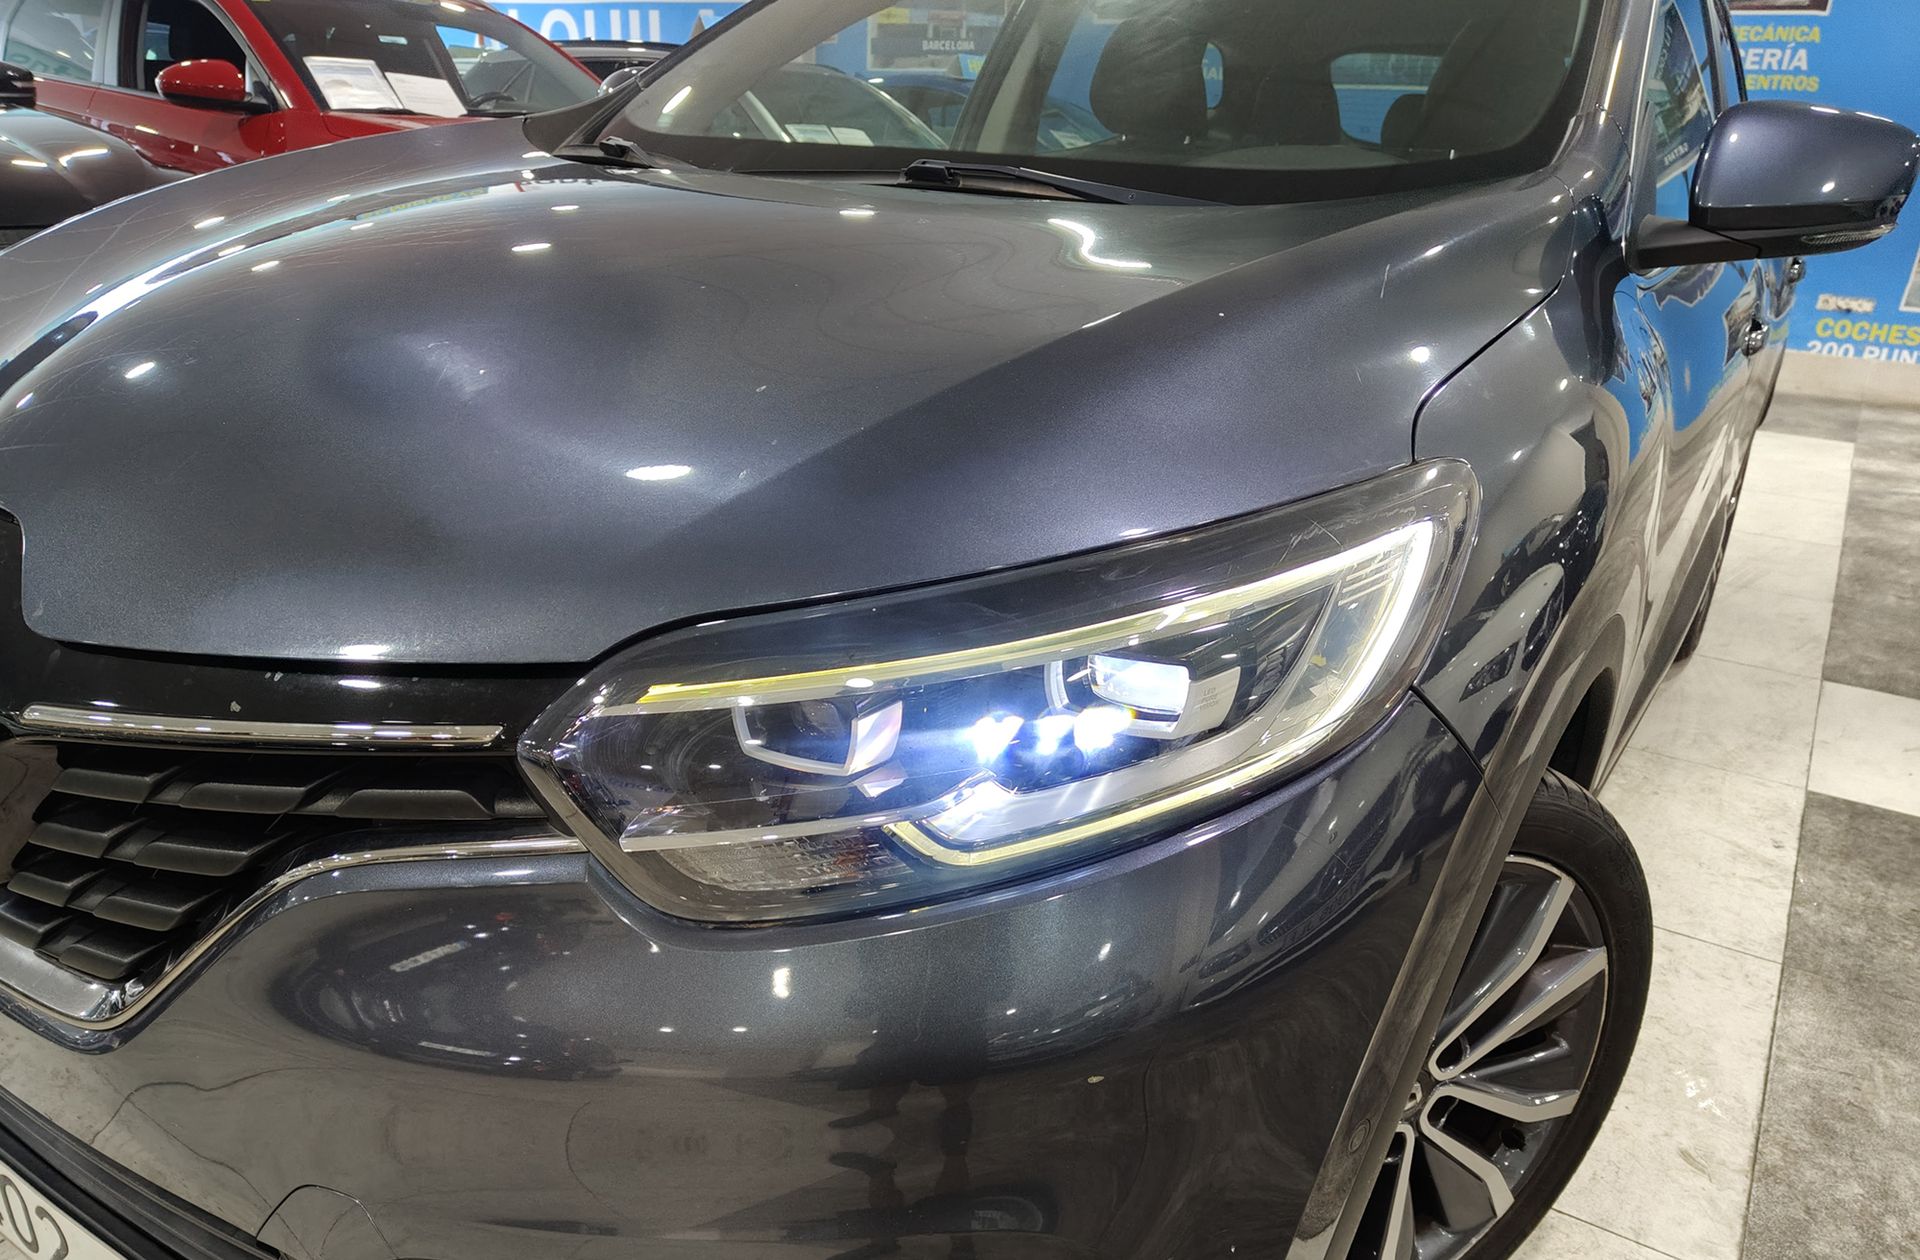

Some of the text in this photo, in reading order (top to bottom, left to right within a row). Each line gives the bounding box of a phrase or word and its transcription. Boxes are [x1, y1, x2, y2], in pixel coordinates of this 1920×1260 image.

[921, 39, 976, 51] BARCELONA
[1734, 22, 1821, 44] ECÁNICA
[1739, 43, 1808, 70] ERÍA
[1745, 74, 1819, 92] ENTROS
[1815, 317, 1920, 346] COCHES
[1807, 340, 1920, 364] 200 PUN
[0, 1174, 70, 1260] 02
